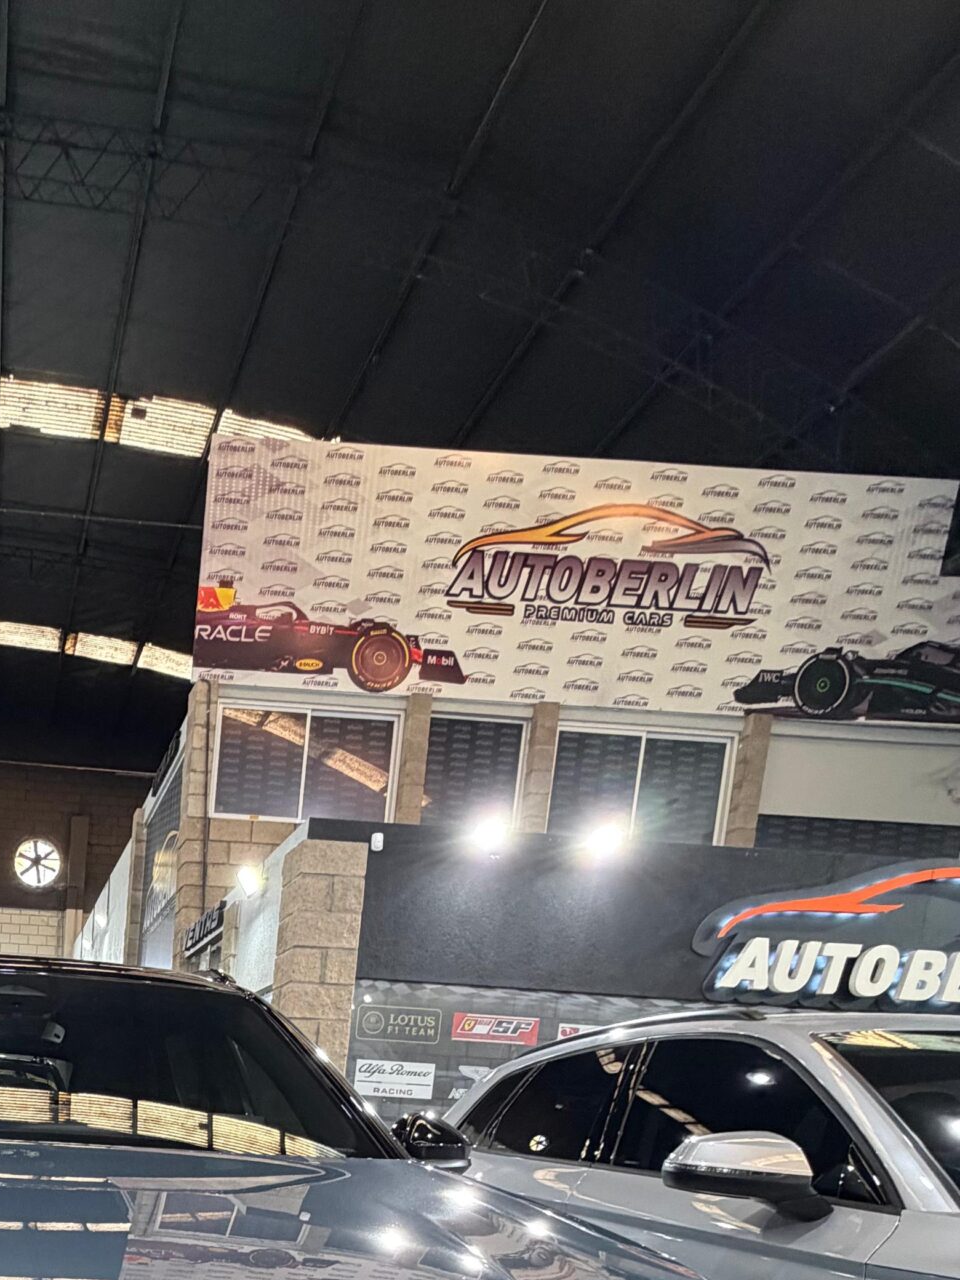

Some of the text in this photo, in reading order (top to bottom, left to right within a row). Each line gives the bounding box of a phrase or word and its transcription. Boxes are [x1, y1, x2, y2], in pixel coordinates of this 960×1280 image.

[326, 452, 364, 460] AUTOBERLIN
[434, 460, 472, 468] AUTOBERLIN
[379, 469, 416, 477] AUTOBERLIN
[543, 466, 580, 474] AUTOBERLIN
[487, 475, 524, 483] AUTOBERLIN
[650, 474, 688, 482] AUTOBERLIN
[324, 478, 360, 487] AUTOBERLIN
[758, 480, 796, 488] AUTOBERLIN
[431, 486, 468, 494] AUTOBERLIN
[594, 483, 631, 491] AUTOBERLIN
[539, 492, 576, 500] AUTOBERLIN
[702, 489, 739, 497] AUTOBERLIN
[376, 494, 413, 502] AUTOBERLIN
[321, 504, 358, 512] AUTOBERLIN
[483, 501, 520, 509] AUTOBERLIN
[647, 500, 683, 508] AUTOBERLIN
[753, 506, 791, 514] AUTOBERLIN
[266, 513, 303, 521] AUTOBERLIN
[428, 511, 465, 519] AUTOBERLIN
[698, 515, 735, 523] AUTOBERLIN
[211, 522, 248, 531] AUTOBERLIN
[643, 525, 679, 533] AUTOBERLIN
[318, 530, 355, 538] AUTOBERLIN
[749, 531, 786, 539] AUTOBERLIN
[263, 539, 300, 547] AUTOBERLIN
[425, 537, 462, 545] AUTOBERLIN
[209, 548, 245, 556] AUTOBERLIN
[315, 555, 352, 563] AUTOBERLIN
[261, 564, 298, 572] AUTOBERLIN
[207, 574, 243, 582] AUTOBERLIN
[367, 571, 404, 579] AUTOBERLIN
[313, 580, 349, 588] AUTOBERLIN
[445, 550, 763, 614] AUTOBERLIN
[258, 589, 295, 597] AUTOBERLIN
[365, 597, 400, 605] AUTOBERLIN
[790, 597, 826, 605] AUTOBERLIN
[415, 612, 452, 620] AUTOBERLIN
[524, 604, 673, 628] PREMIUM CARS
[520, 619, 556, 627] AUTOBERLIN
[785, 622, 822, 630] AUTOBERLIN
[466, 628, 502, 636] AUTOBERLIN
[730, 631, 767, 639] AUTOBERLIN
[570, 634, 607, 642] AUTOBERLIN
[516, 644, 553, 652] AUTOBERLIN
[675, 641, 712, 649] AUTOBERLIN
[621, 650, 657, 658] AUTOBERLIN
[780, 646, 817, 654] AUTOBERLIN
[463, 652, 499, 660] AUTOBERLIN
[725, 656, 762, 664] AUTOBERLIN
[567, 659, 602, 667] AUTOBERLIN
[513, 668, 549, 676] AUTOBERLIN
[671, 665, 707, 673] AUTOBERLIN
[199, 672, 234, 680] AUTOBERLIN
[617, 675, 653, 683] AUTOBERLIN
[758, 672, 781, 683] IWC
[302, 679, 338, 687] AUTOBERLIN
[563, 683, 599, 691] AUTOBERLIN
[612, 699, 648, 707] AUTOBERLIN
[389, 1013, 436, 1027] LOTUS
[492, 1020, 533, 1034] SF
[387, 1026, 435, 1037] F1 TEAM
[358, 1063, 432, 1078] Alfa Romeo
[373, 1087, 413, 1096] RACING
